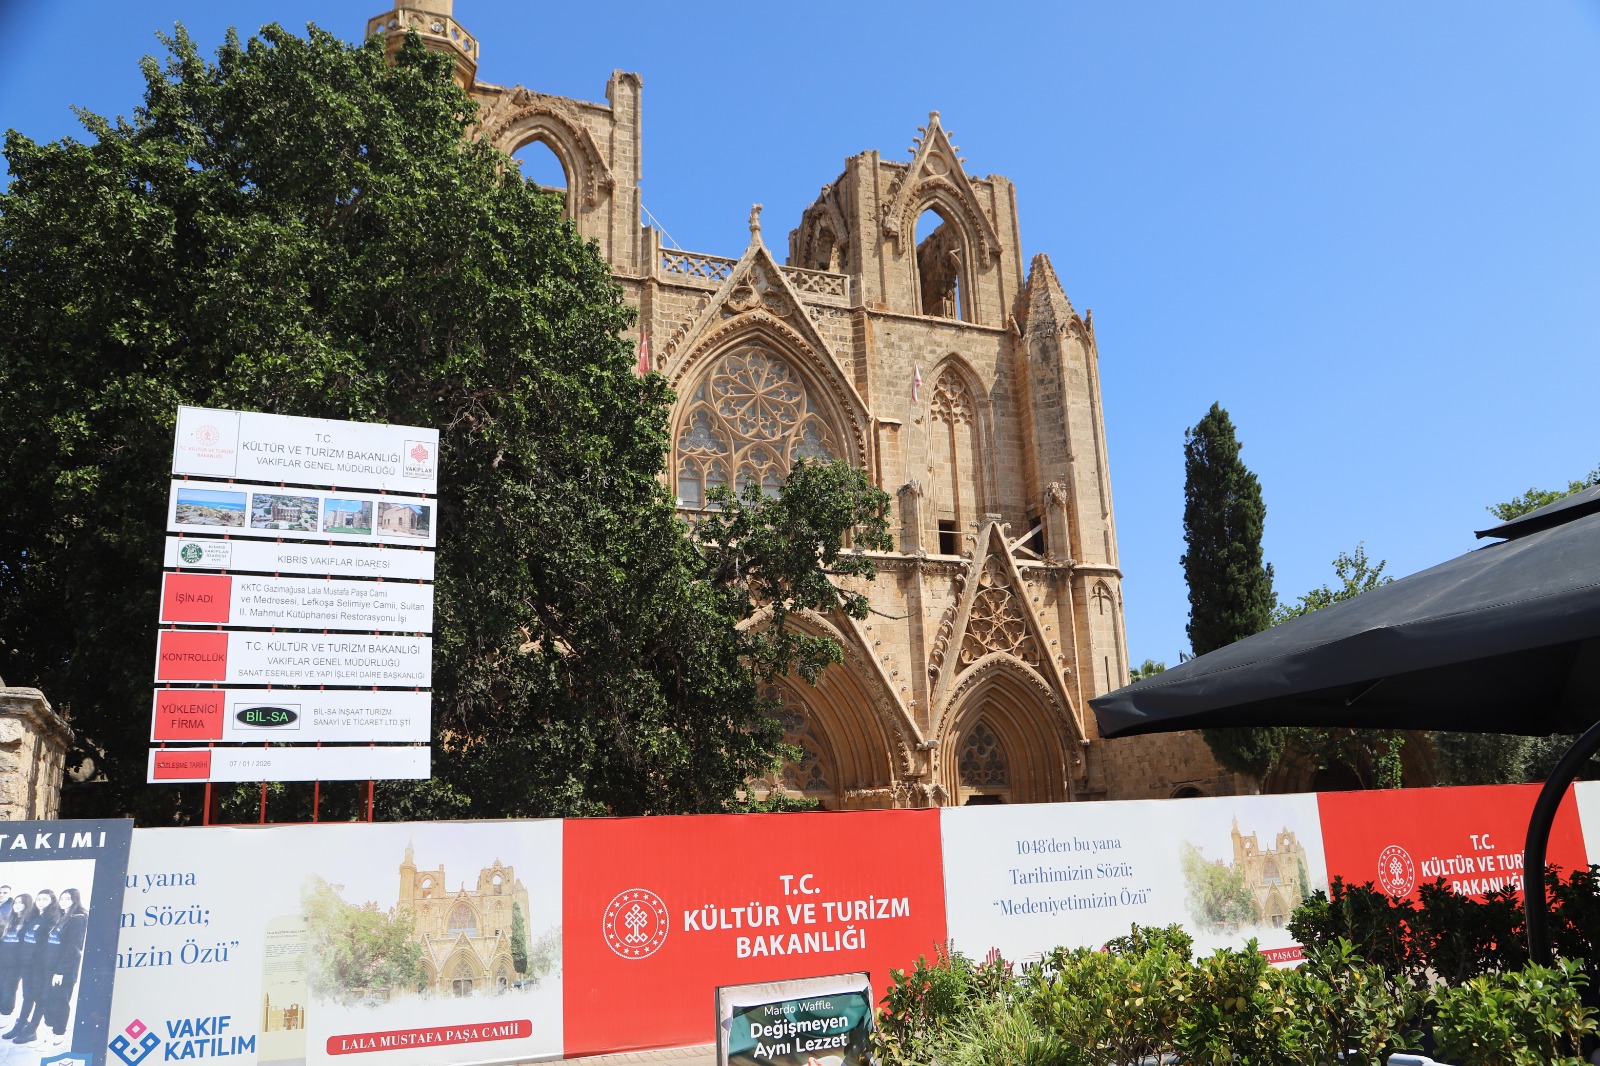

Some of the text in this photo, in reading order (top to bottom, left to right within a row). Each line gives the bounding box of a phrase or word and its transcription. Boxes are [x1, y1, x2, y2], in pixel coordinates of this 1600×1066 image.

[315, 433, 333, 443] T.C.
[242, 440, 400, 463] KÜLTÜR VE TURİZM BAKANLIĞI
[257, 456, 301, 468] VAKIFLAR
[304, 460, 334, 471] GENEL
[337, 462, 396, 476] MÜDÜRLÜĞÜ
[277, 555, 391, 569] KIBRIS VAKIFLAR İDARESİ
[175, 593, 213, 604] İŞİN ADI
[241, 583, 388, 598] KKTC Gazimağusa Lala Mustafa Paşa Camii
[253, 595, 299, 606] Medresesi,
[302, 597, 334, 608] Lefkoşa
[336, 599, 371, 609] Selimiye
[373, 600, 398, 610] Camii,
[400, 602, 425, 611] Sultan
[250, 608, 284, 618] Mahmut
[286, 610, 338, 620] Kütüphanesi
[340, 611, 396, 623] Restorasyonu
[246, 640, 420, 655] T.C. KÜLTÜR VE TURİZM BAKANLIĞI
[162, 652, 225, 662] KONTROLLÜK
[267, 657, 401, 667] VAKIFLAR GENEL MÜDÜRLÜĞÜ
[238, 669, 263, 677] SANAT
[265, 669, 302, 678] ESERLERİ
[316, 670, 333, 678] YAPI
[334, 670, 358, 679] İŞLERİ
[359, 670, 382, 678] DAİRE
[383, 671, 425, 680] BAŞKANLIĞI
[161, 703, 218, 714] YÜKLENİCİ
[246, 709, 289, 722] BİL-SA
[313, 707, 392, 716] BİL-SA İNŞAAT TURİZM
[171, 717, 205, 729] FİRMA
[313, 718, 340, 726] SANAYİ
[341, 718, 352, 726] VE
[353, 717, 383, 726] TİCARET
[1074, 837, 1091, 852] bu
[1092, 837, 1121, 856] yana
[1470, 834, 1494, 850] T.C.
[1421, 854, 1475, 877] KÜLTÜR
[1476, 855, 1495, 872] VE
[141, 871, 197, 893] yana
[1009, 862, 1133, 886] Tarihimizin Sözü;
[779, 873, 820, 896] T.C.
[143, 904, 210, 928] Sözü;
[683, 894, 910, 932] KÜLTÜR VE TURİZM
[736, 925, 866, 959] BAKANLIĞI
[1272, 950, 1291, 961] PAŞA
[764, 1000, 834, 1017] Mardo Waffle,
[165, 1015, 231, 1039] VAKIF
[750, 1014, 849, 1040] Değişmeyen
[341, 1023, 519, 1051] LALA MUSTAFA PAŞA CAMİİ
[164, 1035, 256, 1061] KATILIM
[753, 1034, 848, 1060] Aynı Lezzet
